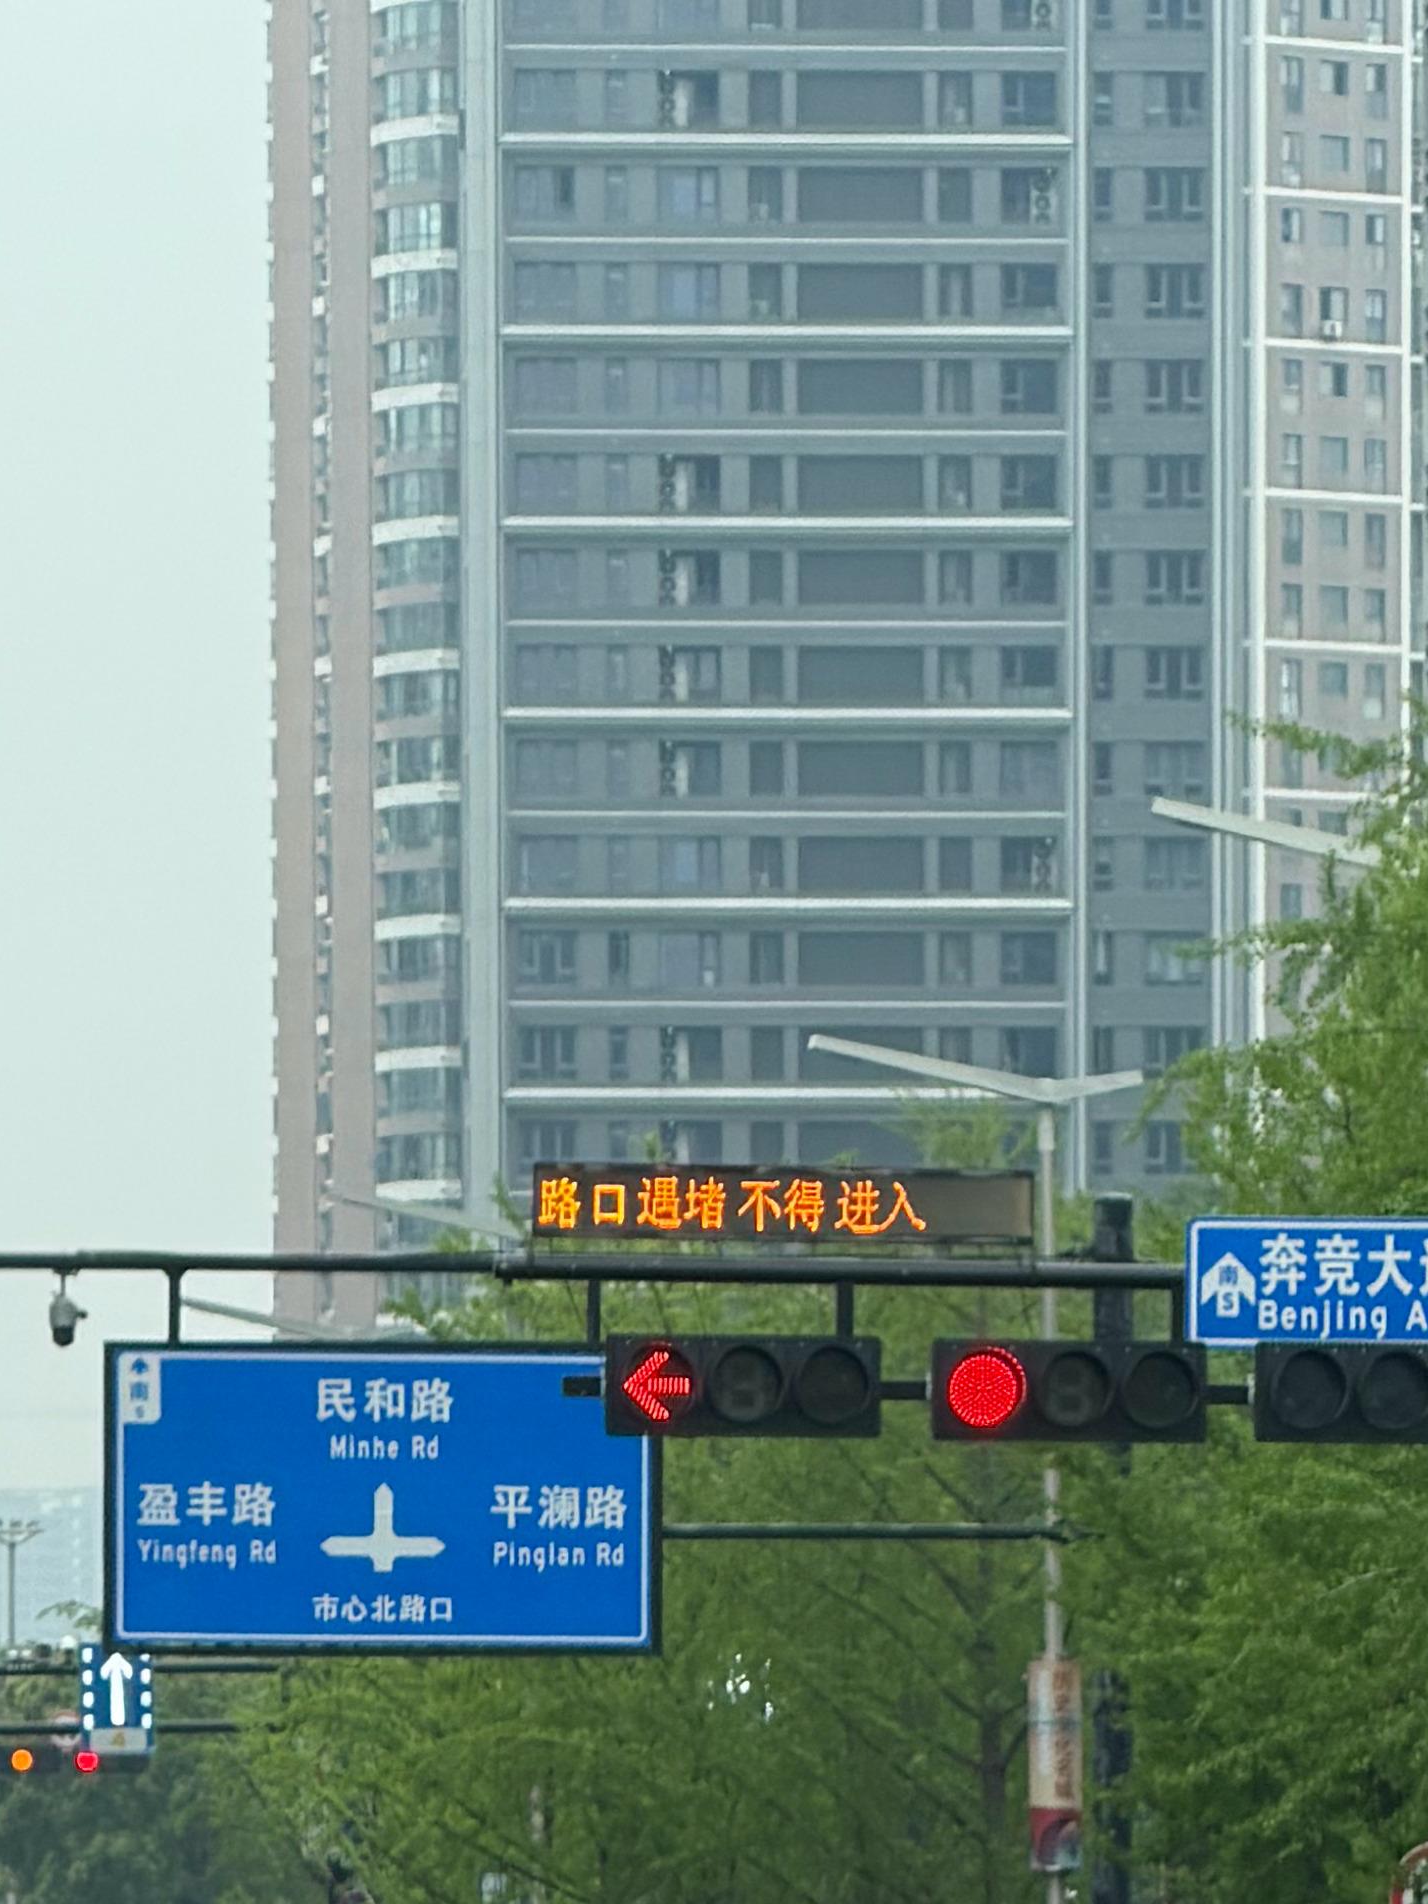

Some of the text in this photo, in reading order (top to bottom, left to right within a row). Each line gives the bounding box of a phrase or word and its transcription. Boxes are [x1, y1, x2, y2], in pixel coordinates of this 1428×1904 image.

[538, 1175, 927, 1235] 路口遇堵不得进入
[1222, 1291, 1235, 1311] S
[1258, 1299, 1388, 1340] Benjing
[316, 1377, 455, 1423] 民和路
[329, 1434, 440, 1460] Minhe Rd
[136, 1481, 276, 1527] 盈丰路
[490, 1484, 628, 1530] 平澜路
[137, 1539, 277, 1570] Yingfeng Rd
[493, 1541, 625, 1573] Pinglan Rd
[312, 1592, 454, 1623] 市心北路口
